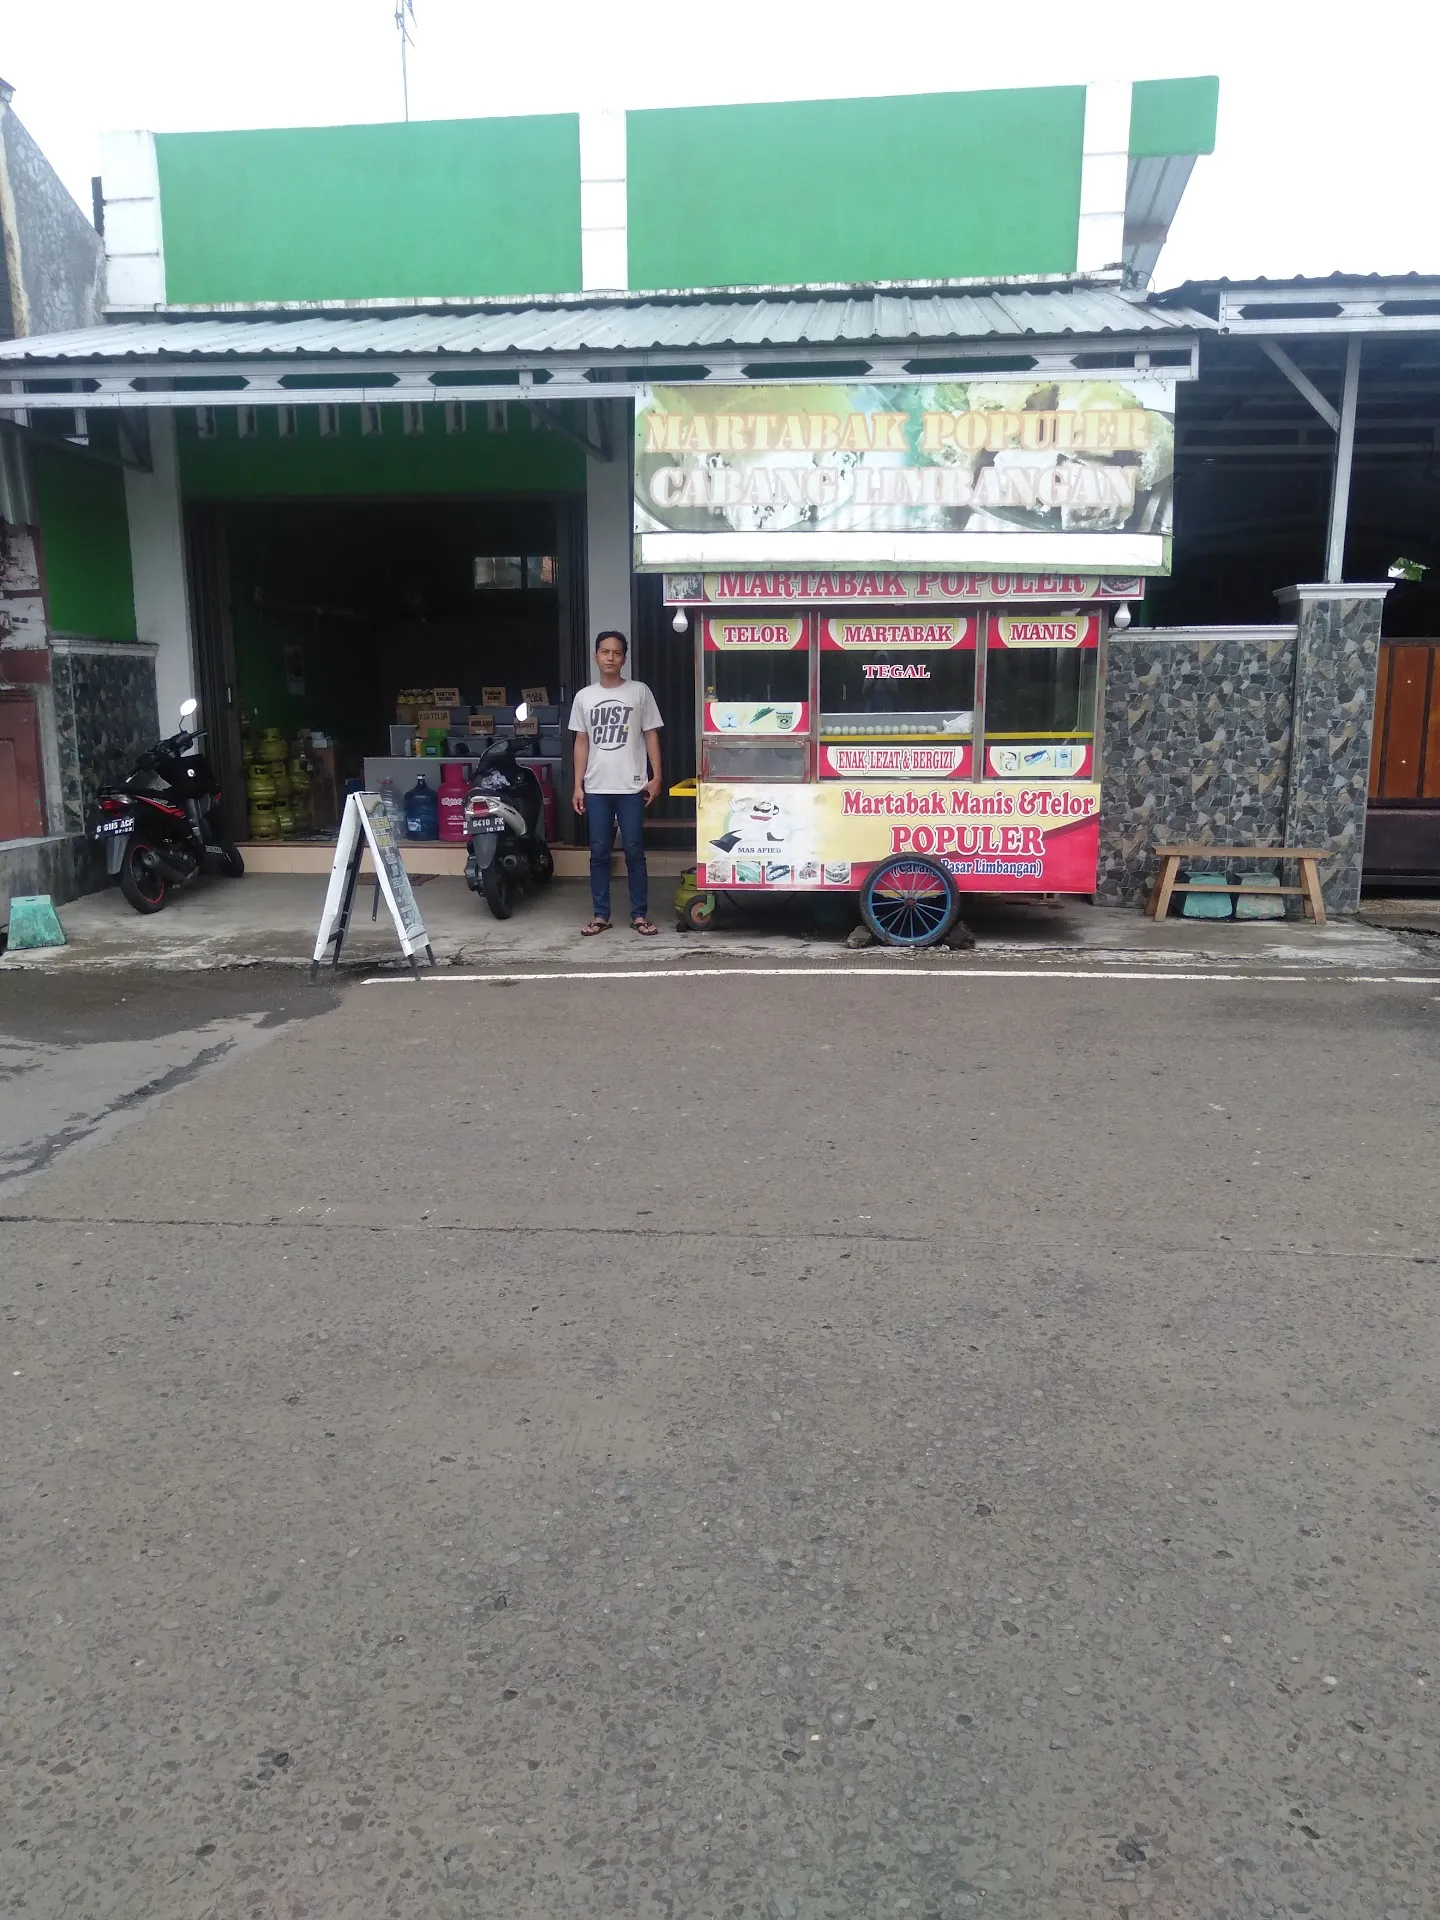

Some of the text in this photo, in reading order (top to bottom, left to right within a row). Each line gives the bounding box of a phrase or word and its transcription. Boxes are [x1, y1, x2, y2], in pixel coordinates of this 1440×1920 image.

[646, 409, 1149, 452] MARTABAK POPULER
[650, 466, 1138, 507] CABANG LIMBANGAN
[716, 573, 1087, 599] MARTABAK POPULER
[723, 624, 790, 643] TELOR
[844, 624, 954, 643] MARTABAK
[1009, 622, 1077, 641] MANIS
[862, 664, 930, 678] TEGAL
[593, 725, 628, 745] CLTH
[870, 749, 899, 769] LEZAT
[902, 749, 911, 769] &
[913, 749, 955, 770] BERGIZI
[842, 789, 946, 816] Martabak
[951, 789, 1013, 815] Manis
[494, 817, 504, 825] FK
[889, 825, 1045, 855] POPULER
[974, 858, 1043, 878] Limbangan)
